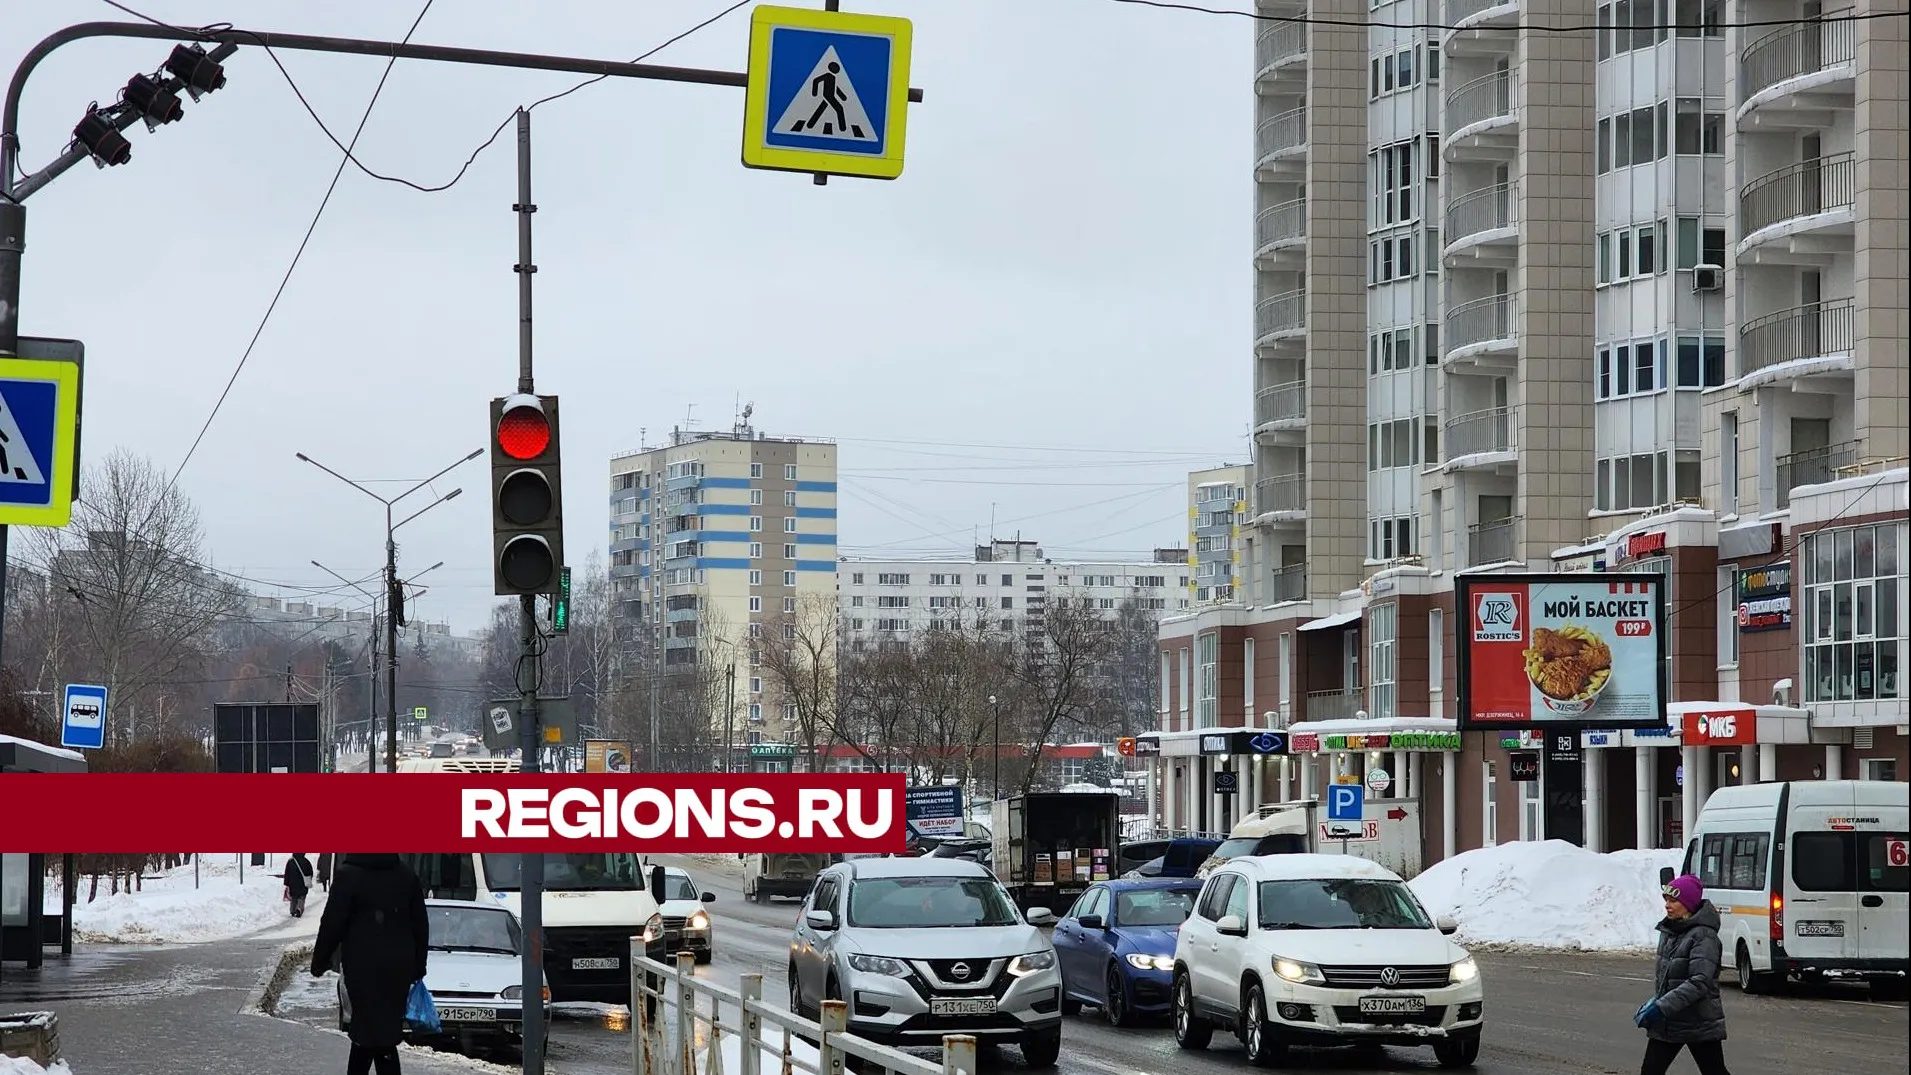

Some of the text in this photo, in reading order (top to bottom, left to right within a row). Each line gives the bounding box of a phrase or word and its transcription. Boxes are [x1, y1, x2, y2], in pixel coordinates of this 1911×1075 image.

[1544, 595, 1649, 618] МОЙ БАСКЕТ
[1476, 632, 1521, 640] ROSTIC'S
[1708, 715, 1737, 739] МКБ
[1390, 731, 1462, 749] ОПТИКА
[759, 746, 793, 754] АПТЕКА
[912, 789, 954, 798] СПОРТИВНОЙ
